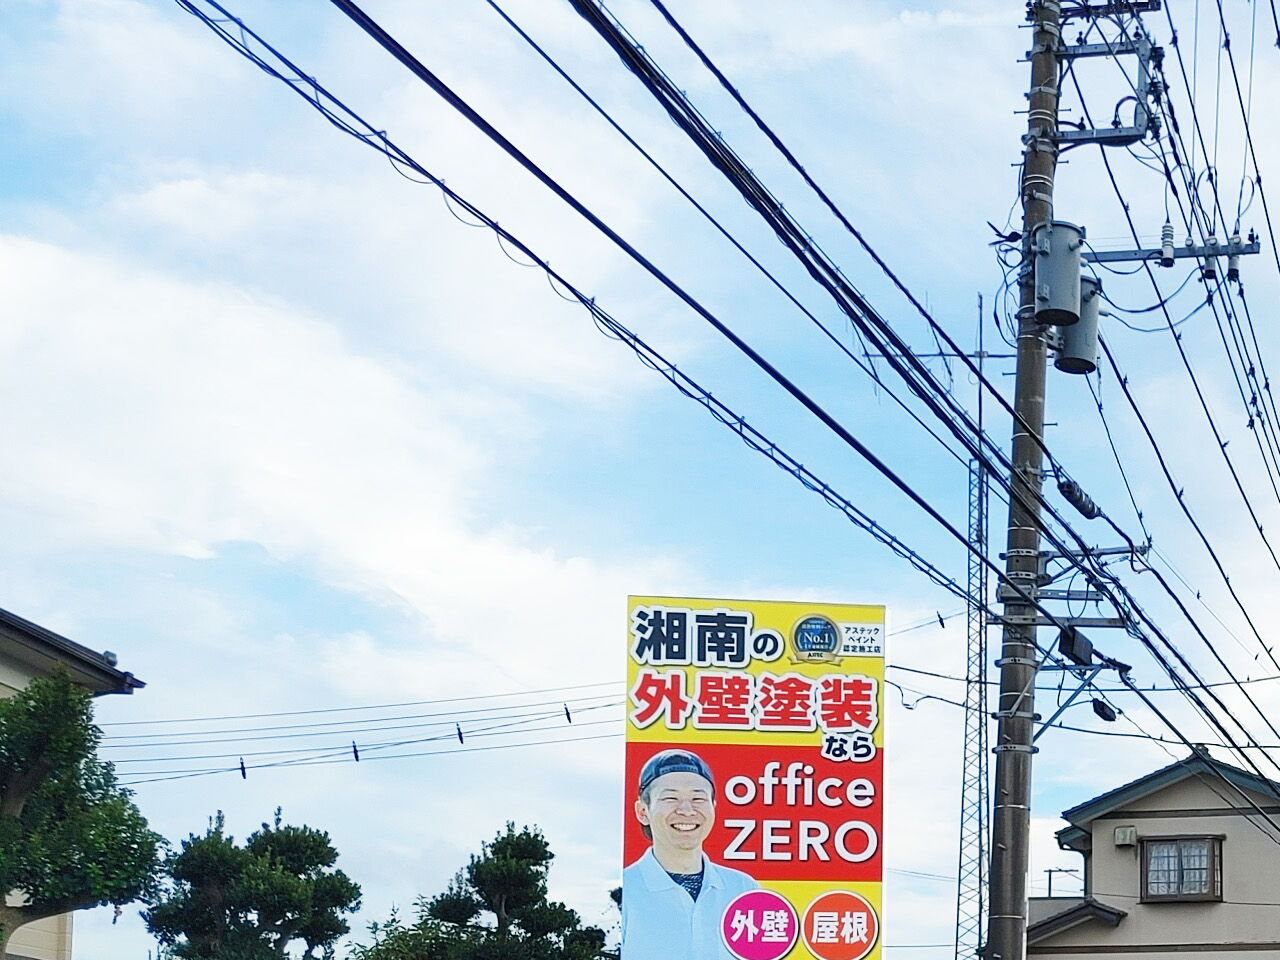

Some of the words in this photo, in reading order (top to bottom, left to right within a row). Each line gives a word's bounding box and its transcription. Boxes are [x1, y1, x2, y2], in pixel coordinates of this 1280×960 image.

[633, 610, 780, 663] 湘南の
[803, 632, 830, 644] No.1
[844, 626, 880, 635] アステック
[848, 636, 876, 644] ペイント
[843, 645, 882, 654] 認定施工店
[634, 673, 876, 729] 外壁塗装
[825, 735, 874, 758] なら
[724, 762, 875, 808] office
[723, 819, 878, 863] ZERO
[730, 909, 789, 943] 外壁
[810, 911, 869, 944] 屋根
